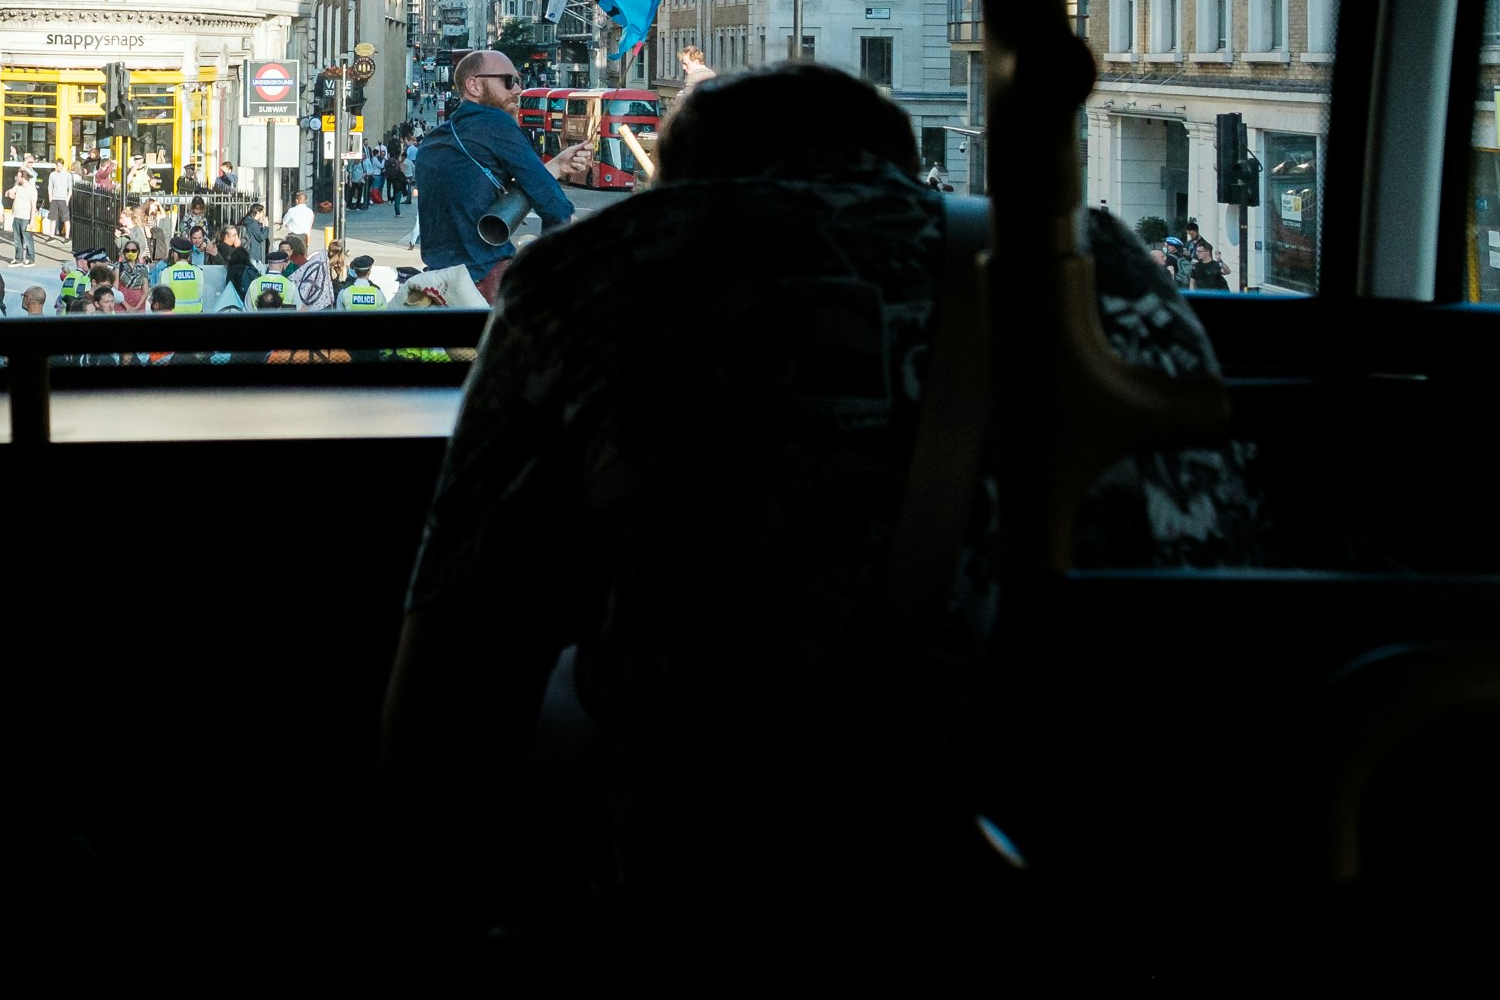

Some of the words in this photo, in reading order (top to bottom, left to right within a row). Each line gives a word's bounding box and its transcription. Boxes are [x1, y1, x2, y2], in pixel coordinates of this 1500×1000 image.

[46, 33, 145, 50] snappysnaps
[258, 105, 288, 113] SUBWAY
[173, 270, 195, 280] POLICE
[261, 281, 283, 292] POLICE
[353, 294, 374, 304] POLICE
